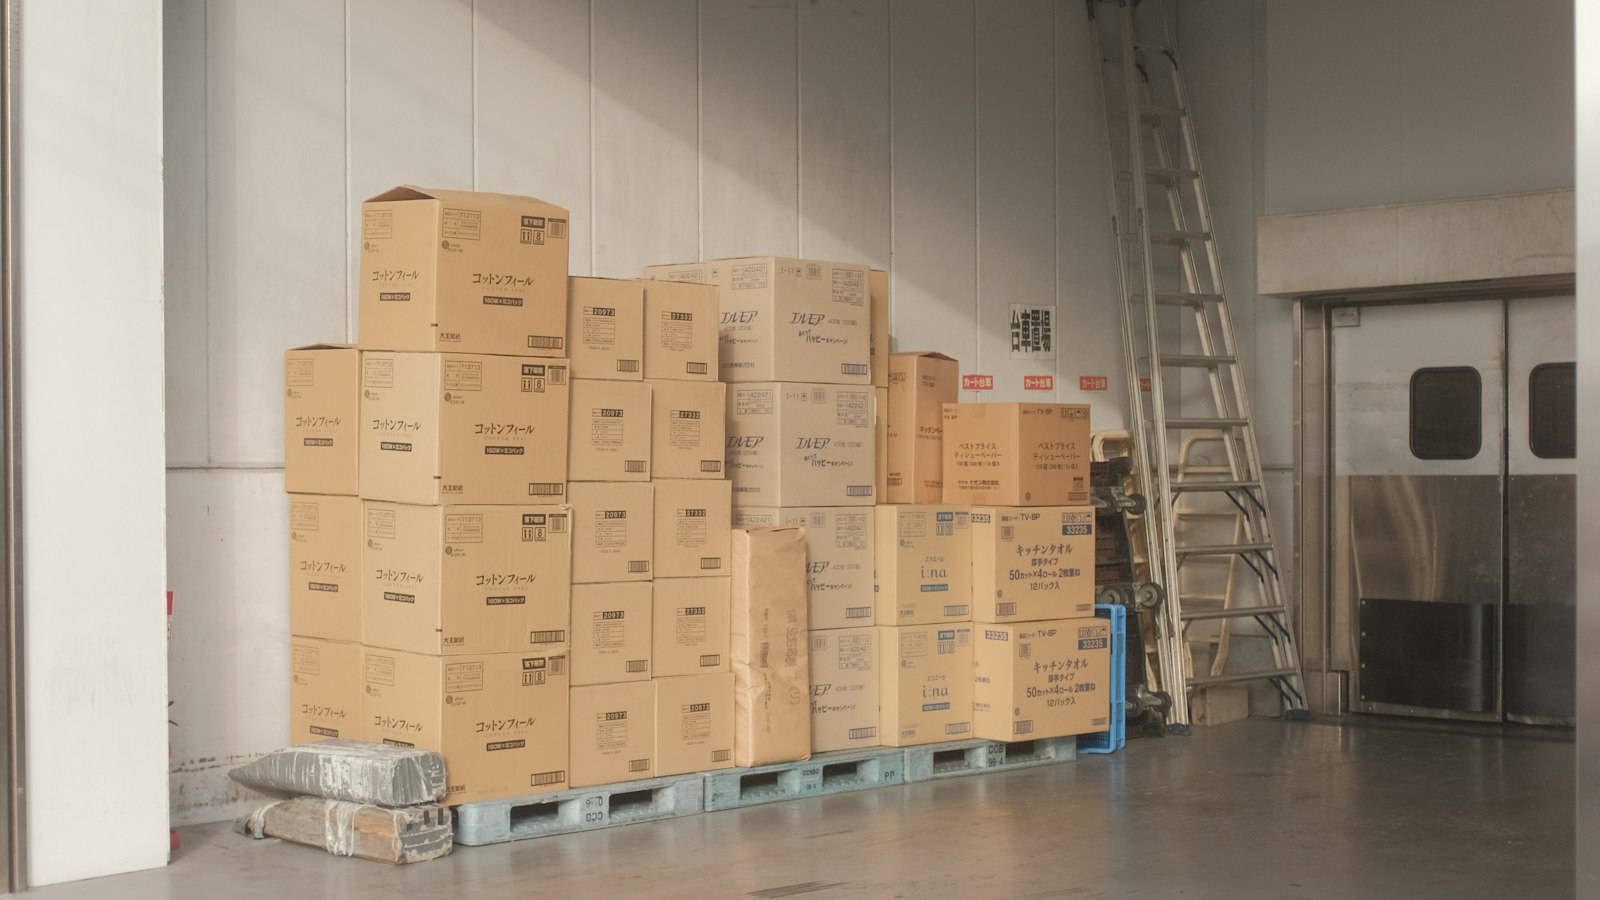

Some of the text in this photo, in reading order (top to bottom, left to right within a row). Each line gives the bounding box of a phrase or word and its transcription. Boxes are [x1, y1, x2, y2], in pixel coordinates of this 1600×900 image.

[372, 270, 420, 282] コットンフィール
[472, 273, 534, 286] コットンフィール
[720, 311, 758, 324] エルモア
[790, 312, 826, 326] エルモア
[1010, 309, 1051, 352] 台車置場
[963, 376, 992, 387] カート台車
[1025, 377, 1052, 388] カート台車
[1081, 378, 1106, 388] カート台車
[296, 416, 342, 428] コットンフィール
[372, 419, 422, 432] コットンフィール
[474, 423, 535, 435] コットンフィール
[725, 436, 764, 448] エルモア
[796, 438, 830, 450] エルモア
[1066, 526, 1088, 534] 33235
[1017, 544, 1073, 556] キッチンタオル
[300, 560, 346, 573] コットンフィール
[921, 566, 948, 578] i:na
[376, 569, 424, 583] コットンフィール
[476, 574, 536, 586] コットンフィール
[1010, 569, 1057, 581] 50カット×4ロール
[1030, 581, 1060, 590] 12パック入
[986, 631, 1008, 640] 33235
[1082, 640, 1102, 649] 33235
[1033, 658, 1088, 673] キッチンタオル
[922, 685, 948, 698] i:na
[1027, 685, 1073, 698] 50カット×4ロール
[1046, 697, 1076, 707] 12パック入
[302, 704, 346, 718] コットンフィール
[606, 712, 627, 720] 20973
[374, 716, 424, 732] コットンフィール
[476, 717, 536, 732] コットンフィール
[884, 771, 895, 780] PP
